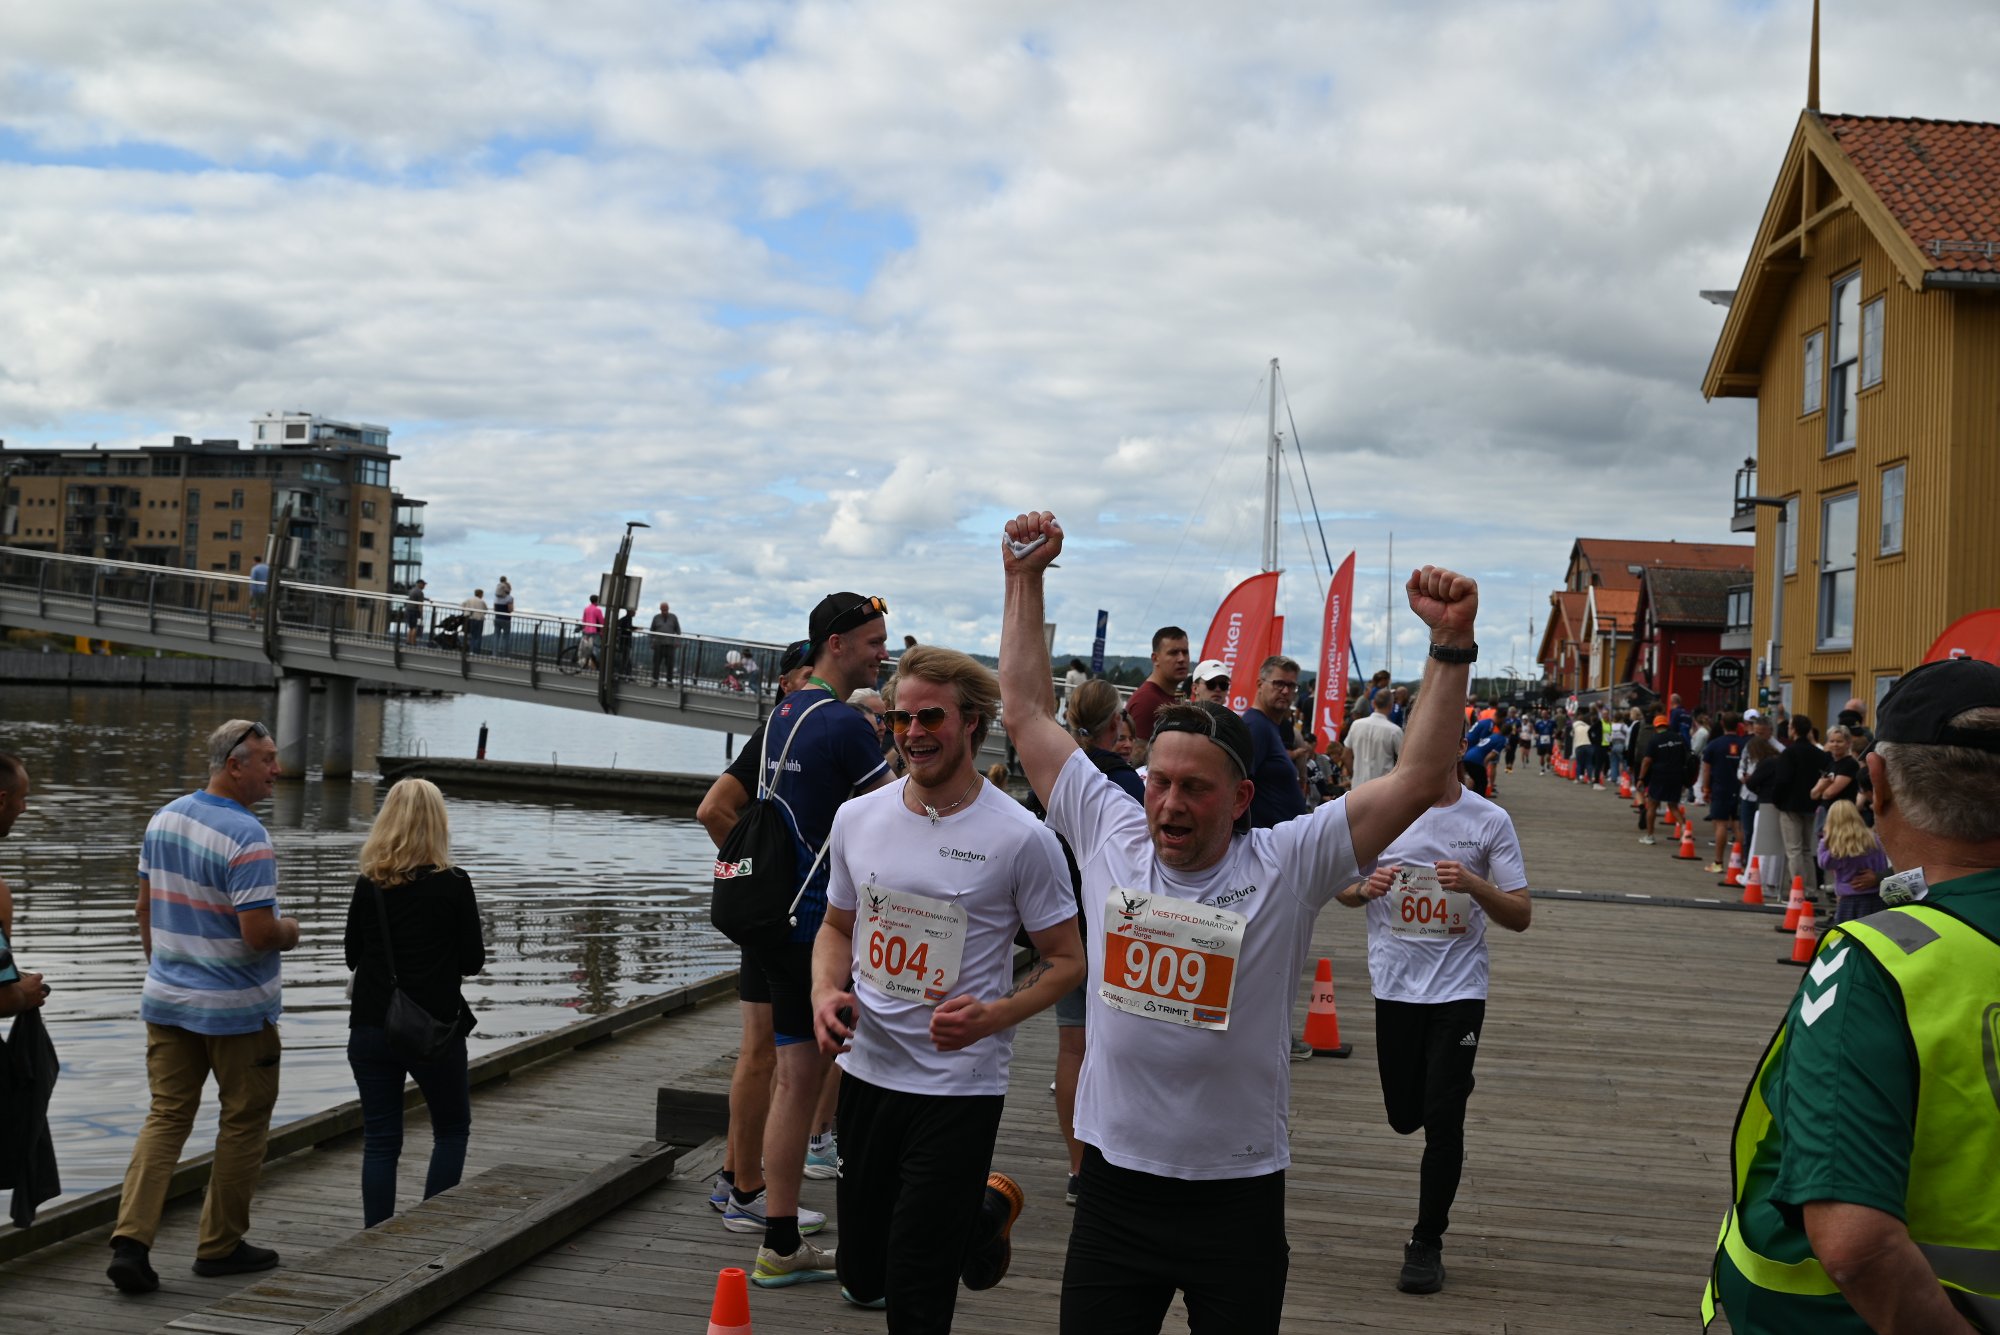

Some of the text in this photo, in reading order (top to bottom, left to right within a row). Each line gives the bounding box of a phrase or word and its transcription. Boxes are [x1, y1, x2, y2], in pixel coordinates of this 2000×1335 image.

[1716, 668, 1739, 677] STEAK
[1401, 895, 1460, 925] 604 3
[1151, 909, 1234, 932] VESTFOLDMARATON
[1133, 931, 1152, 939] Norge
[1134, 924, 1175, 938] Sparebanken
[869, 930, 929, 981] 604
[933, 968, 944, 986] 2
[1123, 941, 1206, 1000] 909
[896, 984, 921, 995] TRIMIT
[1157, 1004, 1189, 1018] TRIMIT
